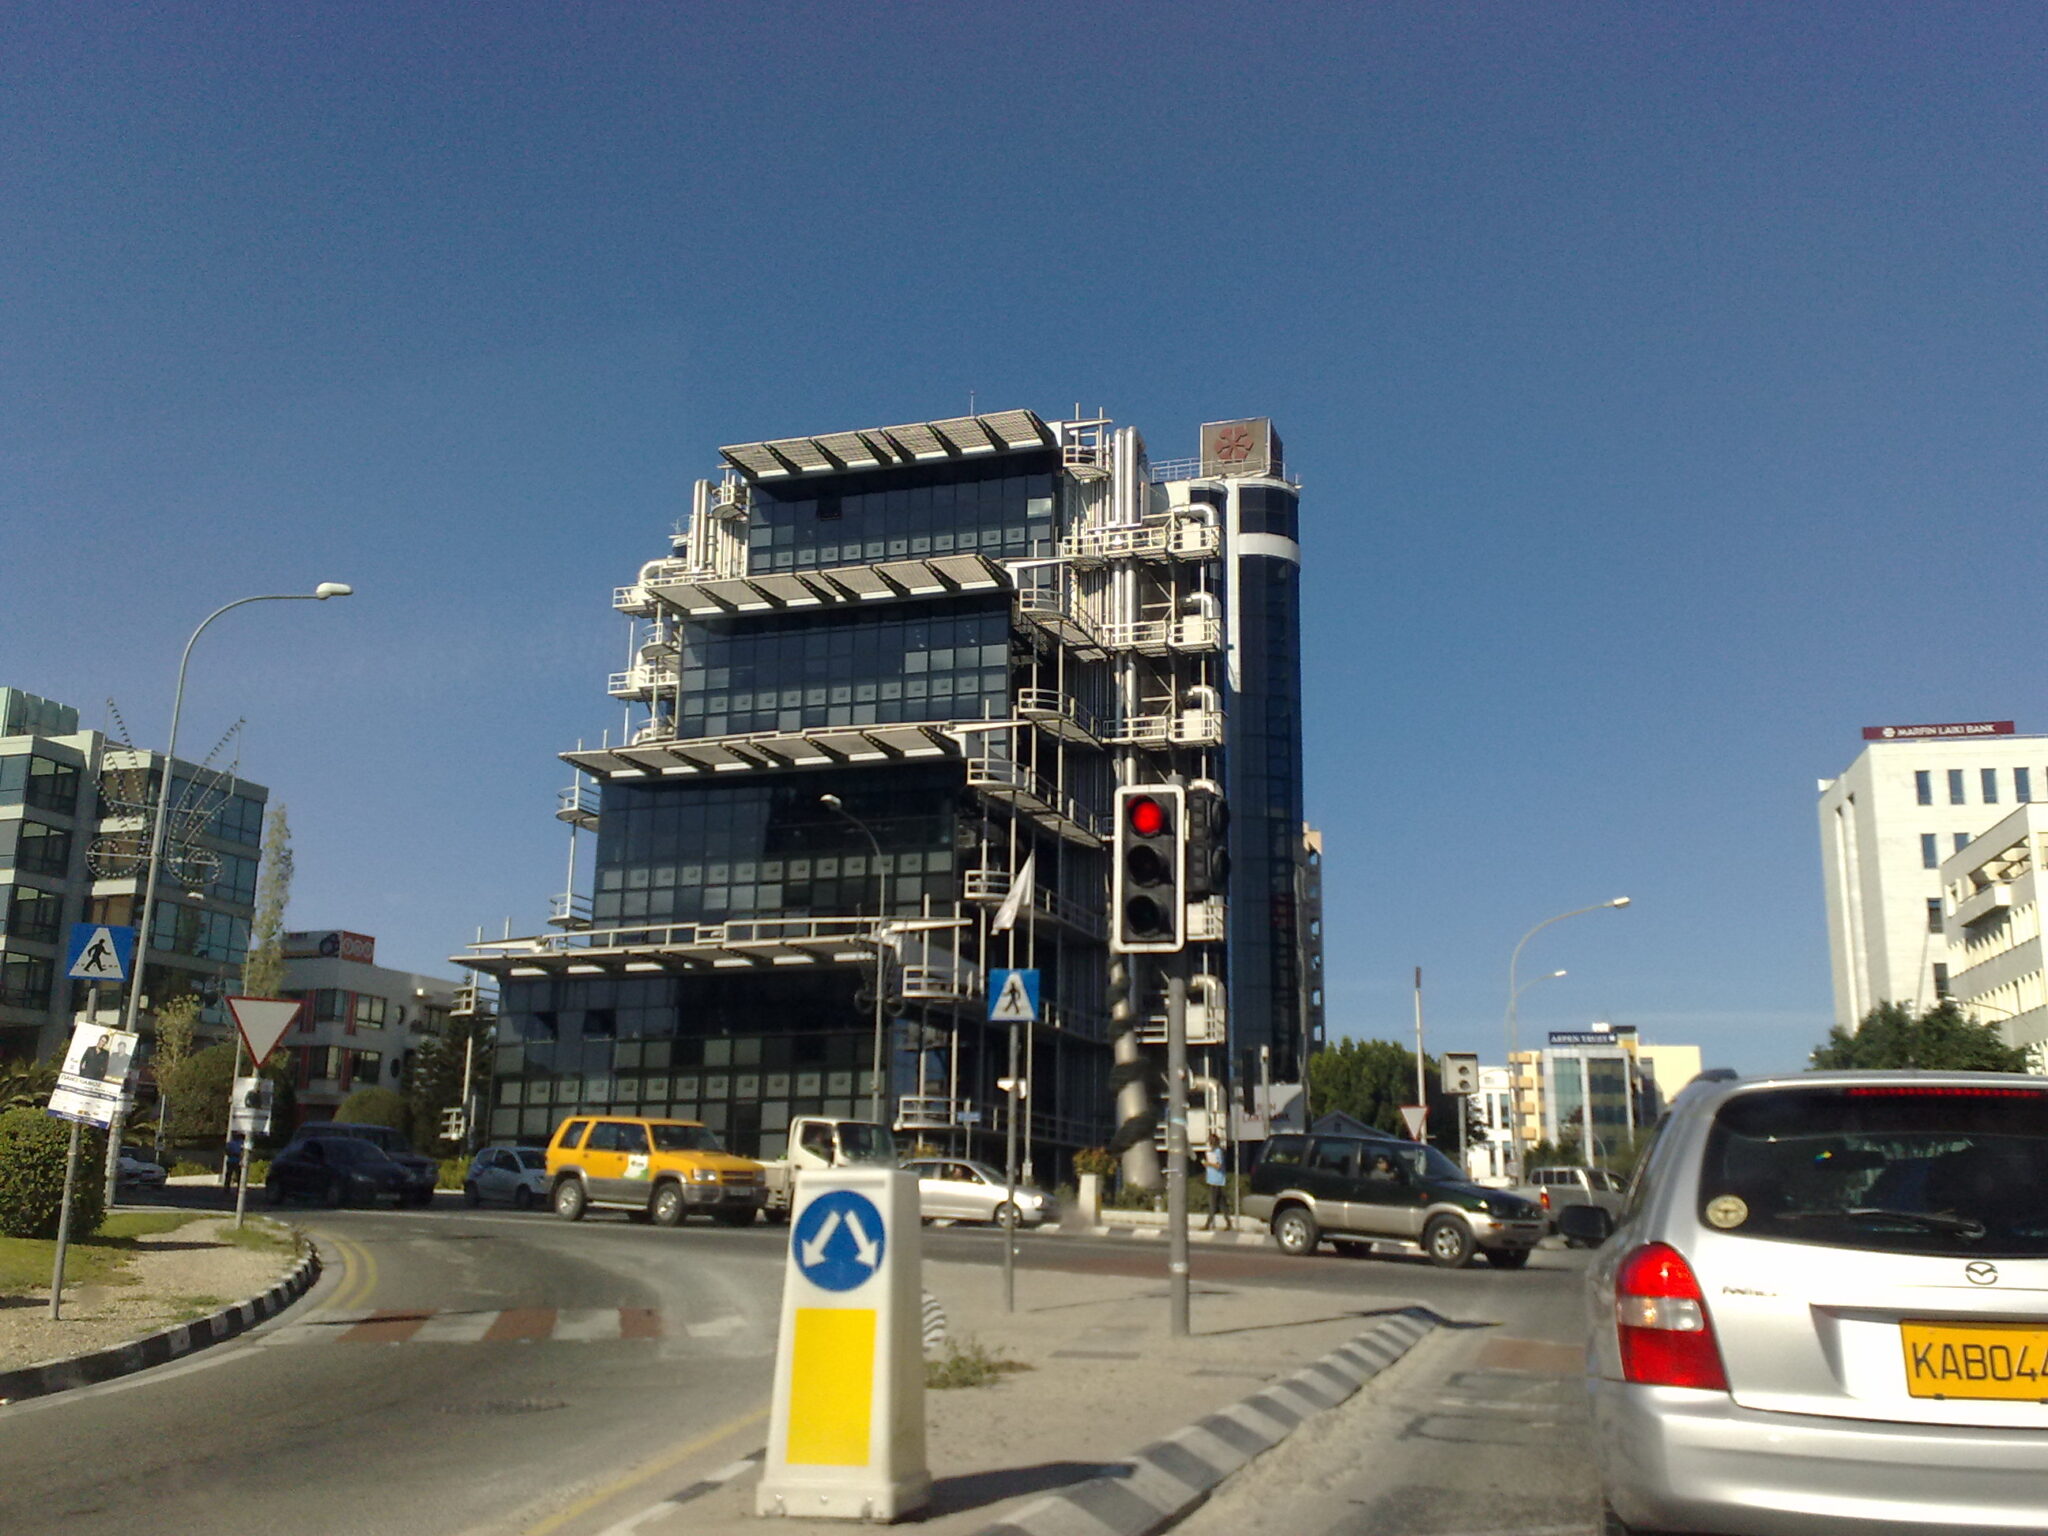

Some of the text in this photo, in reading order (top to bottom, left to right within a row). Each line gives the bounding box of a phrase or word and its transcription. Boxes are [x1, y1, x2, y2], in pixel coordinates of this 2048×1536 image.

[1897, 724, 1995, 737] MARFIN LAIKI BANK
